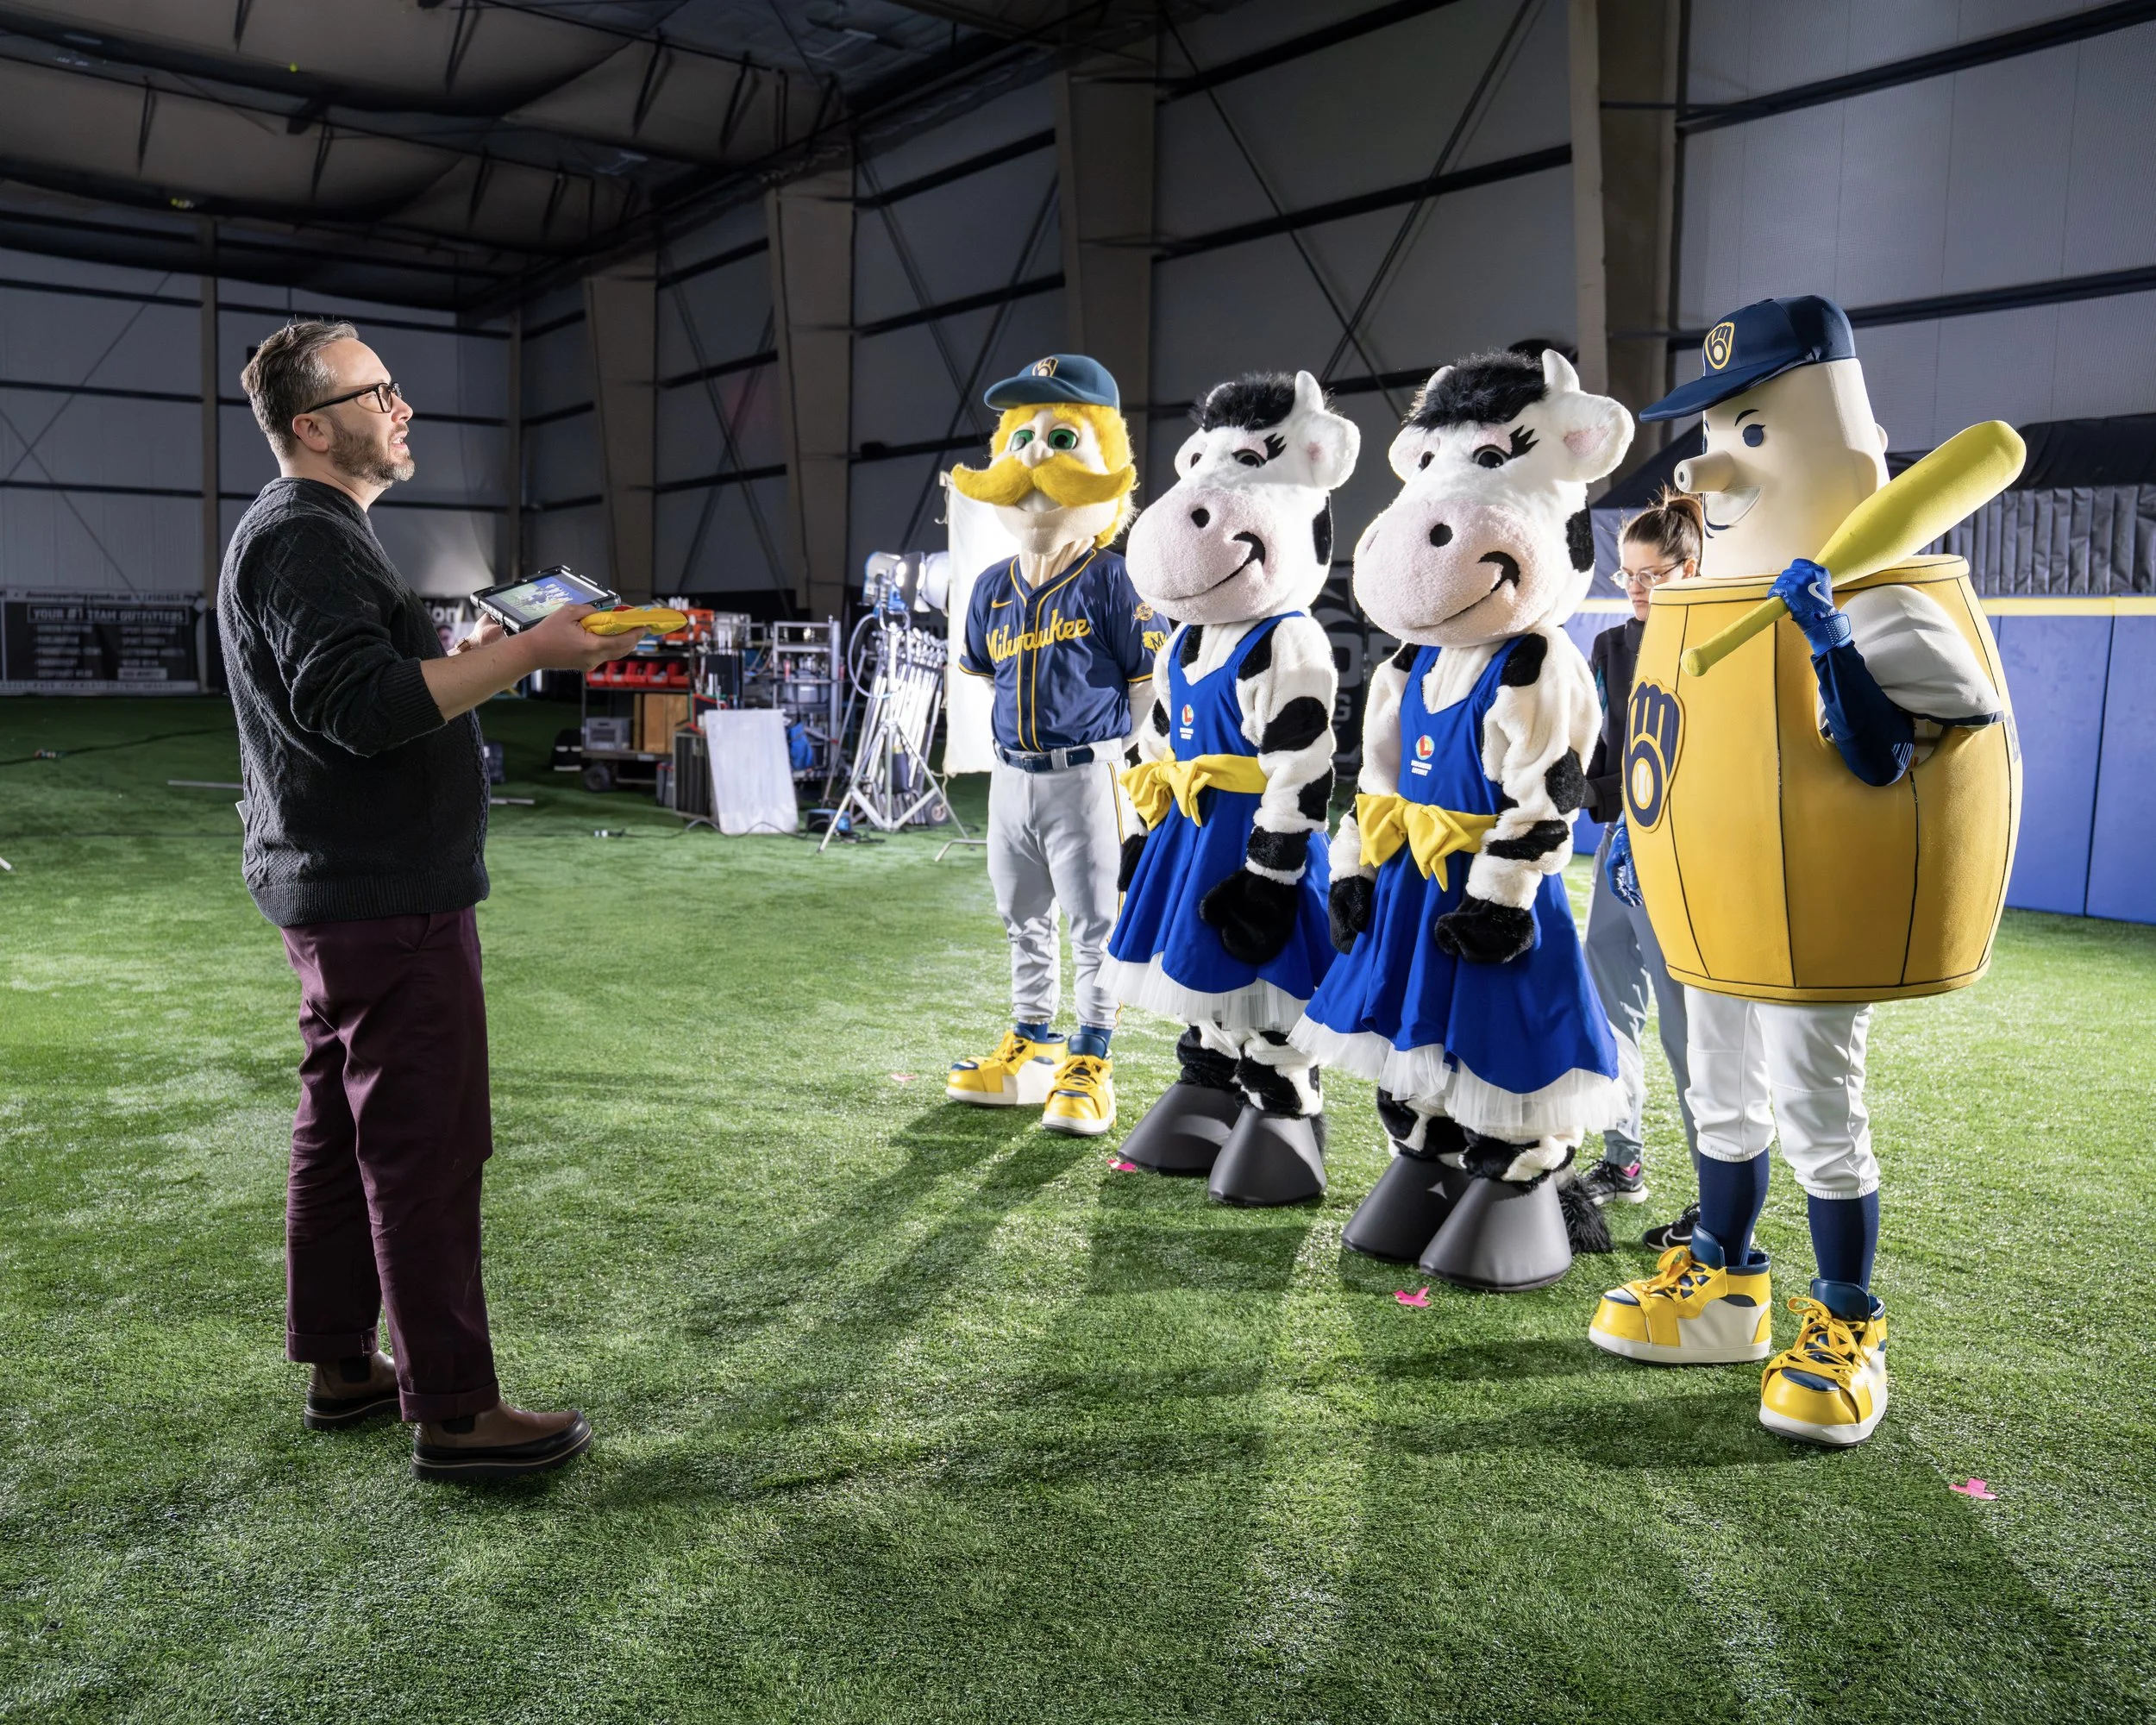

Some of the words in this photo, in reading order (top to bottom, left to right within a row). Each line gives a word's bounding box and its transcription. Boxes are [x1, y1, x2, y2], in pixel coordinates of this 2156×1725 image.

[33, 607, 64, 619] YOUR
[86, 608, 116, 620] TEAM
[119, 609, 184, 623] OUTFITTERS
[986, 608, 1091, 663] Milwaukee
